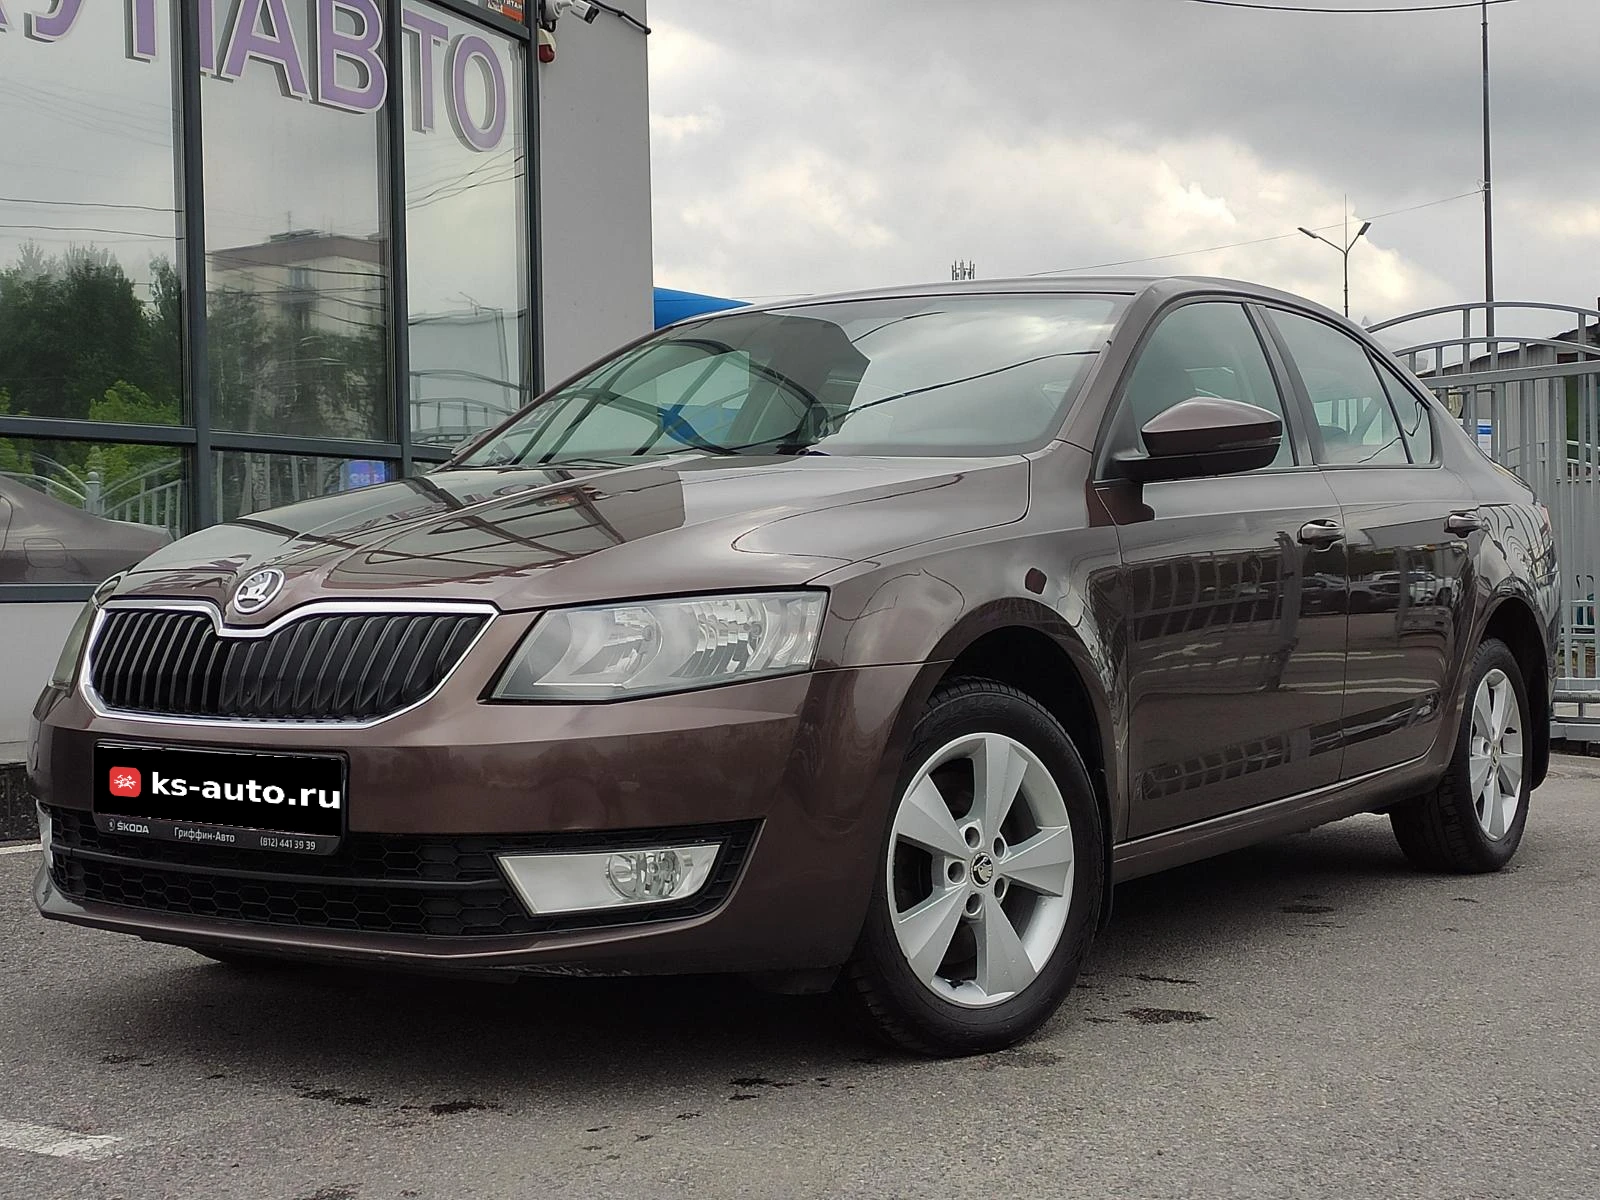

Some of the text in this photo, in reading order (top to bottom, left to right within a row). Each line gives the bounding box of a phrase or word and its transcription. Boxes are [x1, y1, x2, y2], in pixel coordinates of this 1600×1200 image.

[174, 826, 236, 843] Гриффин-Авто
[260, 836, 316, 851] (812) 441 39 39
